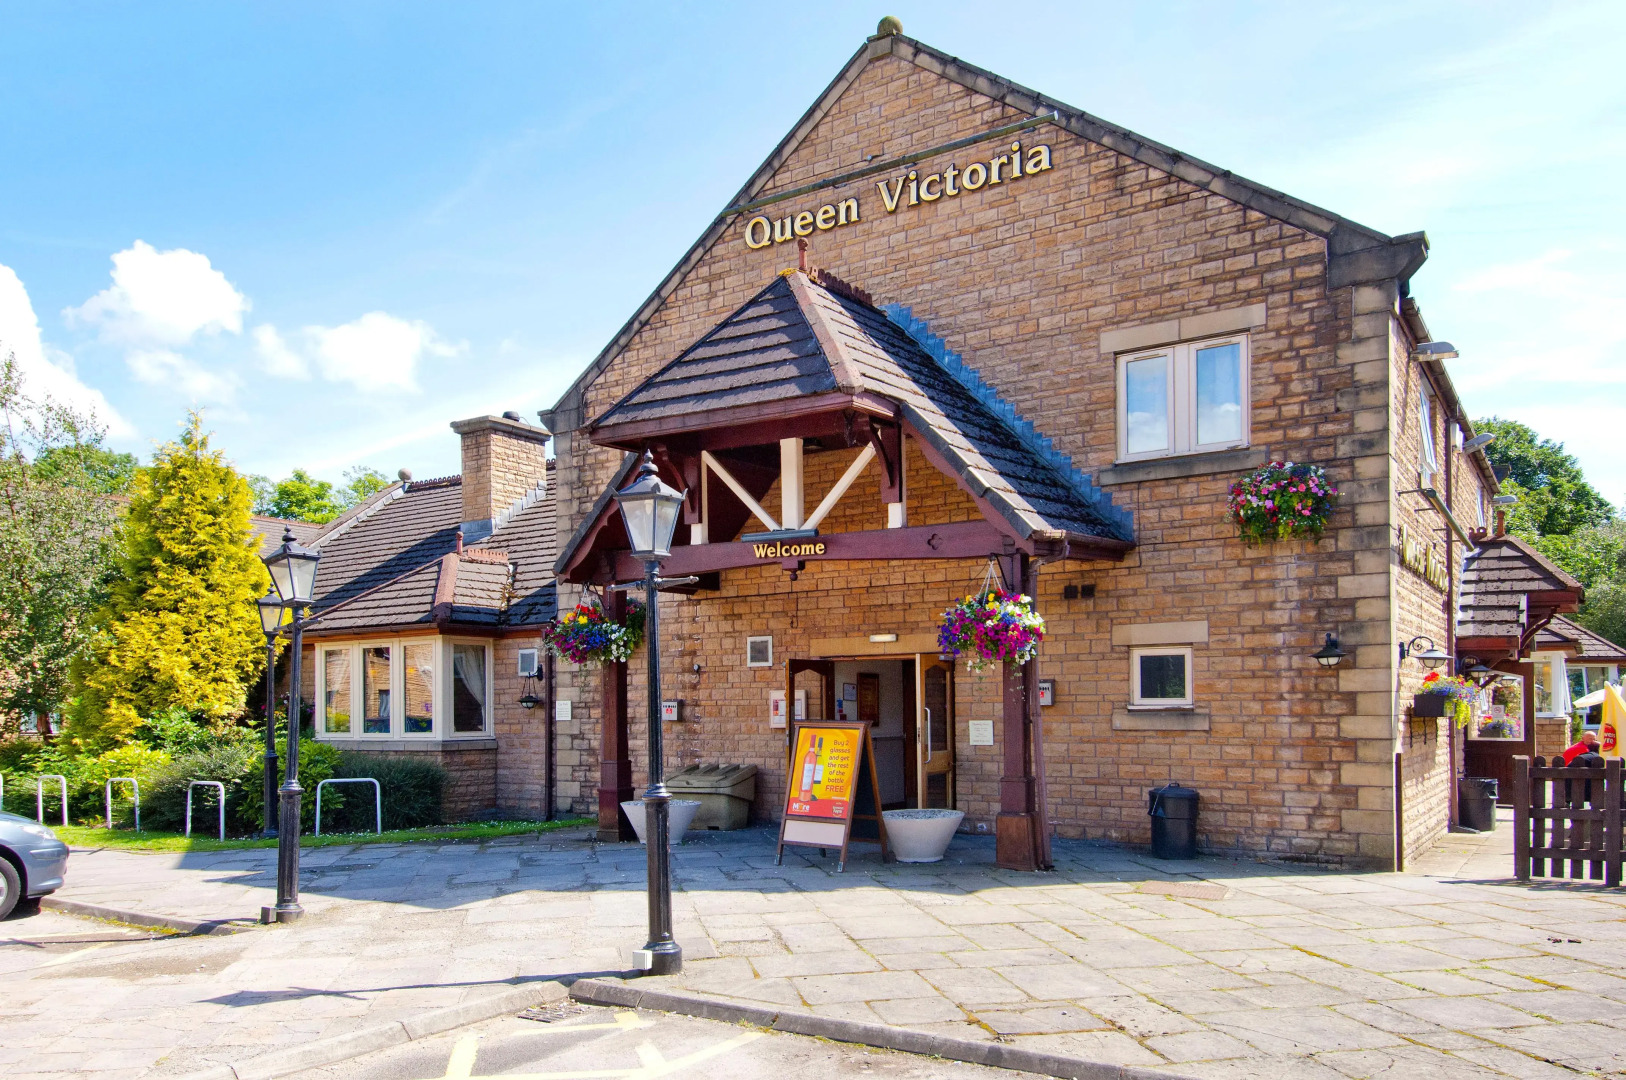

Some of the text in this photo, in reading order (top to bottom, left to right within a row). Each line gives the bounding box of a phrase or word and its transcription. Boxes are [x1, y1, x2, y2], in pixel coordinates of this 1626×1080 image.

[744, 140, 1053, 249] Queen Victoria
[752, 541, 826, 559] Welcome
[825, 785, 844, 793] FREE
